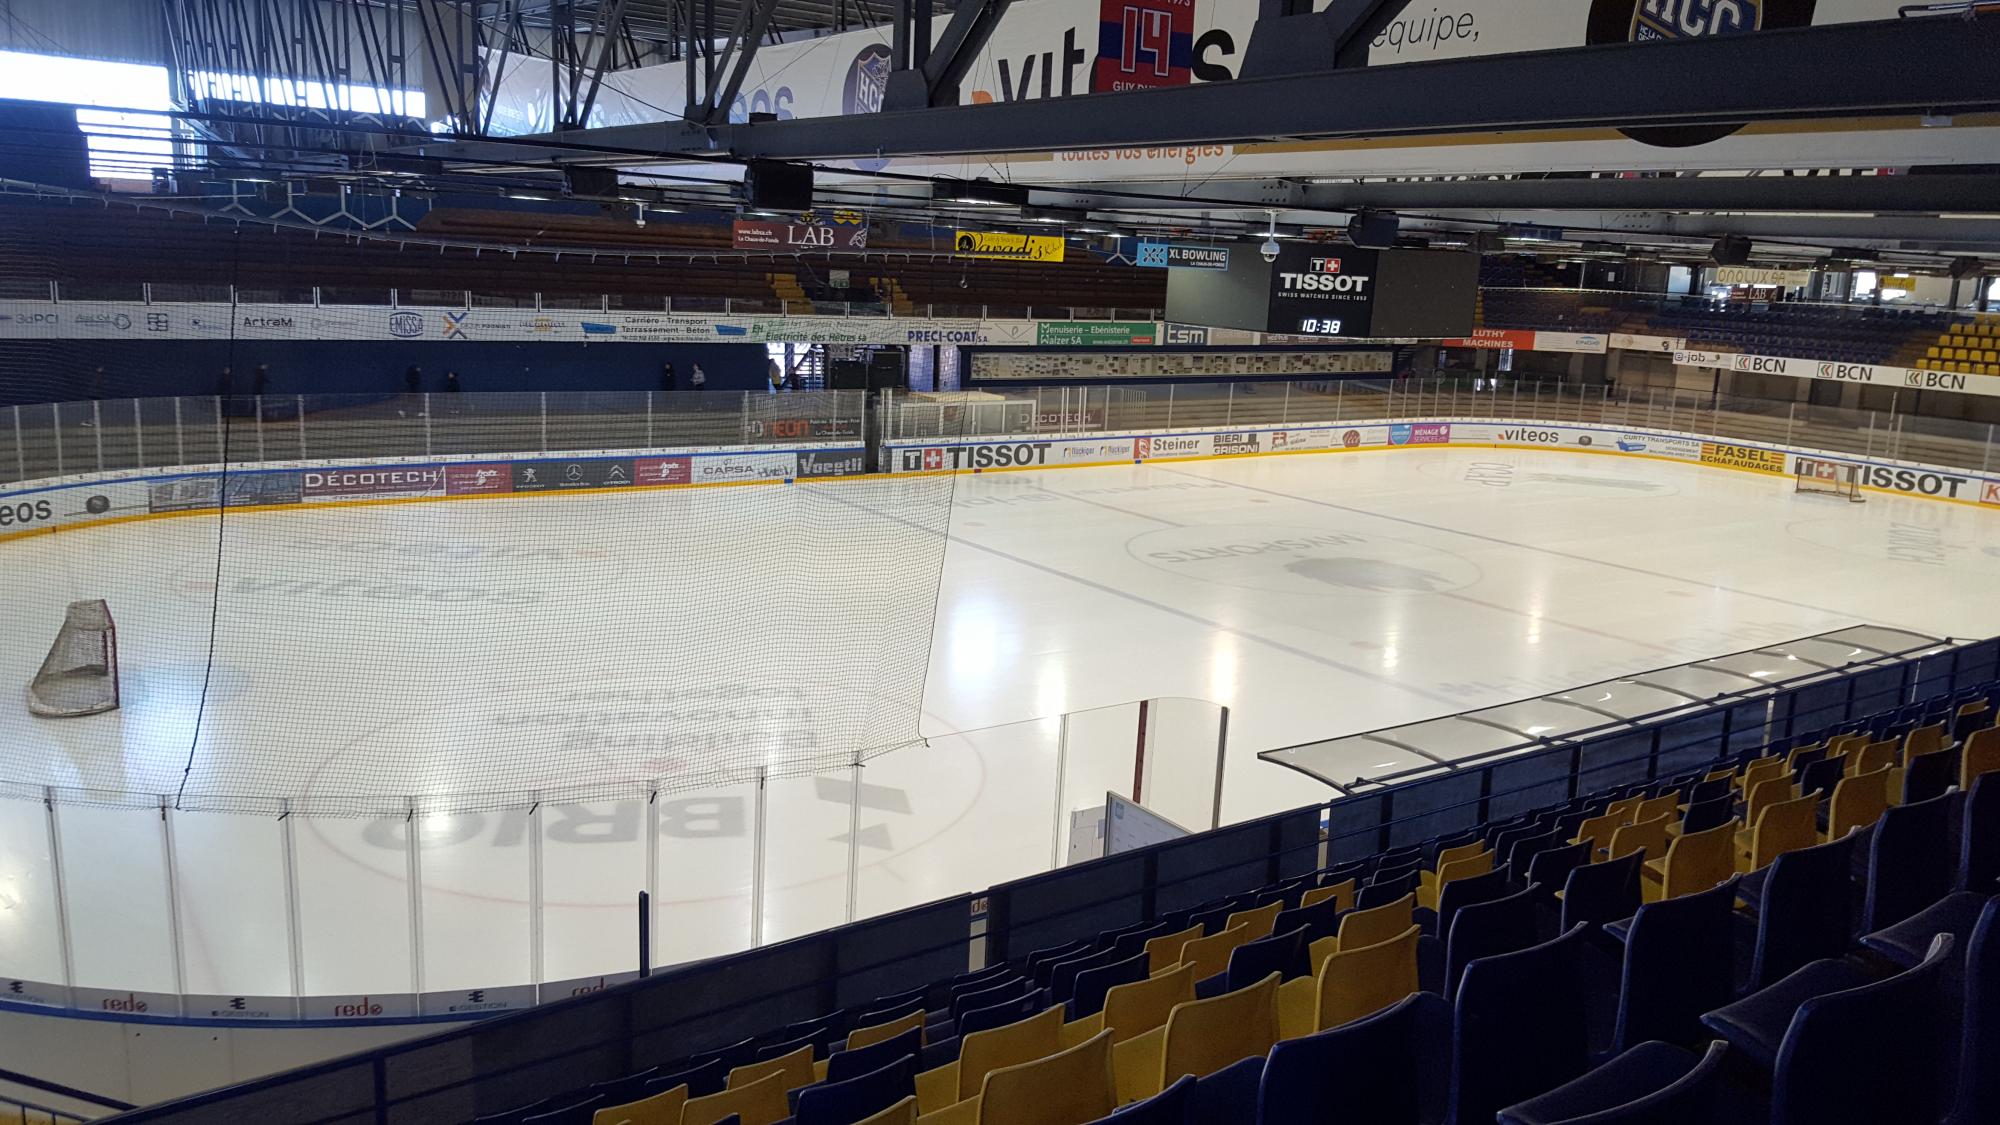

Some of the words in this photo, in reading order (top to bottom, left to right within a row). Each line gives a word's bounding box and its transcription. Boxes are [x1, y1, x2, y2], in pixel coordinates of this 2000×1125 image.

[1121, 6, 1171, 77] 14
[787, 225, 835, 246] LAB
[1169, 248, 1181, 259] XL
[1182, 249, 1226, 262] BOWLING
[1280, 273, 1369, 292] TISSOT
[1300, 292, 1329, 300] WATCHES
[667, 317, 708, 326] Transport
[1041, 323, 1083, 334] Menuiserie
[1302, 319, 1341, 334] 10:38
[622, 325, 679, 334] Terrassement
[908, 330, 977, 342] PRECI-COAT
[1167, 324, 1204, 344] tsm
[811, 333, 826, 342] des
[1041, 335, 1069, 345] Walzer
[1071, 336, 1082, 345] SA
[1462, 338, 1514, 349] MACHINES
[1753, 357, 1786, 374] BCN
[1836, 364, 1873, 381] BCN
[1925, 372, 1966, 390] BCN
[1213, 433, 1243, 444] BIERI
[1505, 427, 1559, 443] viteos
[1623, 433, 1646, 442] CURTY
[1648, 436, 1689, 447] TRANSPORTS
[1153, 437, 1200, 451] Steiner
[1213, 443, 1259, 455] GRISONI
[946, 443, 1052, 469] TISSOT
[1715, 444, 1770, 463] FASEL
[703, 465, 754, 476] CAPSA
[1700, 455, 1784, 473] ECHAFAUDAGES
[305, 470, 437, 488] DÉCOTECH
[1846, 465, 1967, 498] TISSOT
